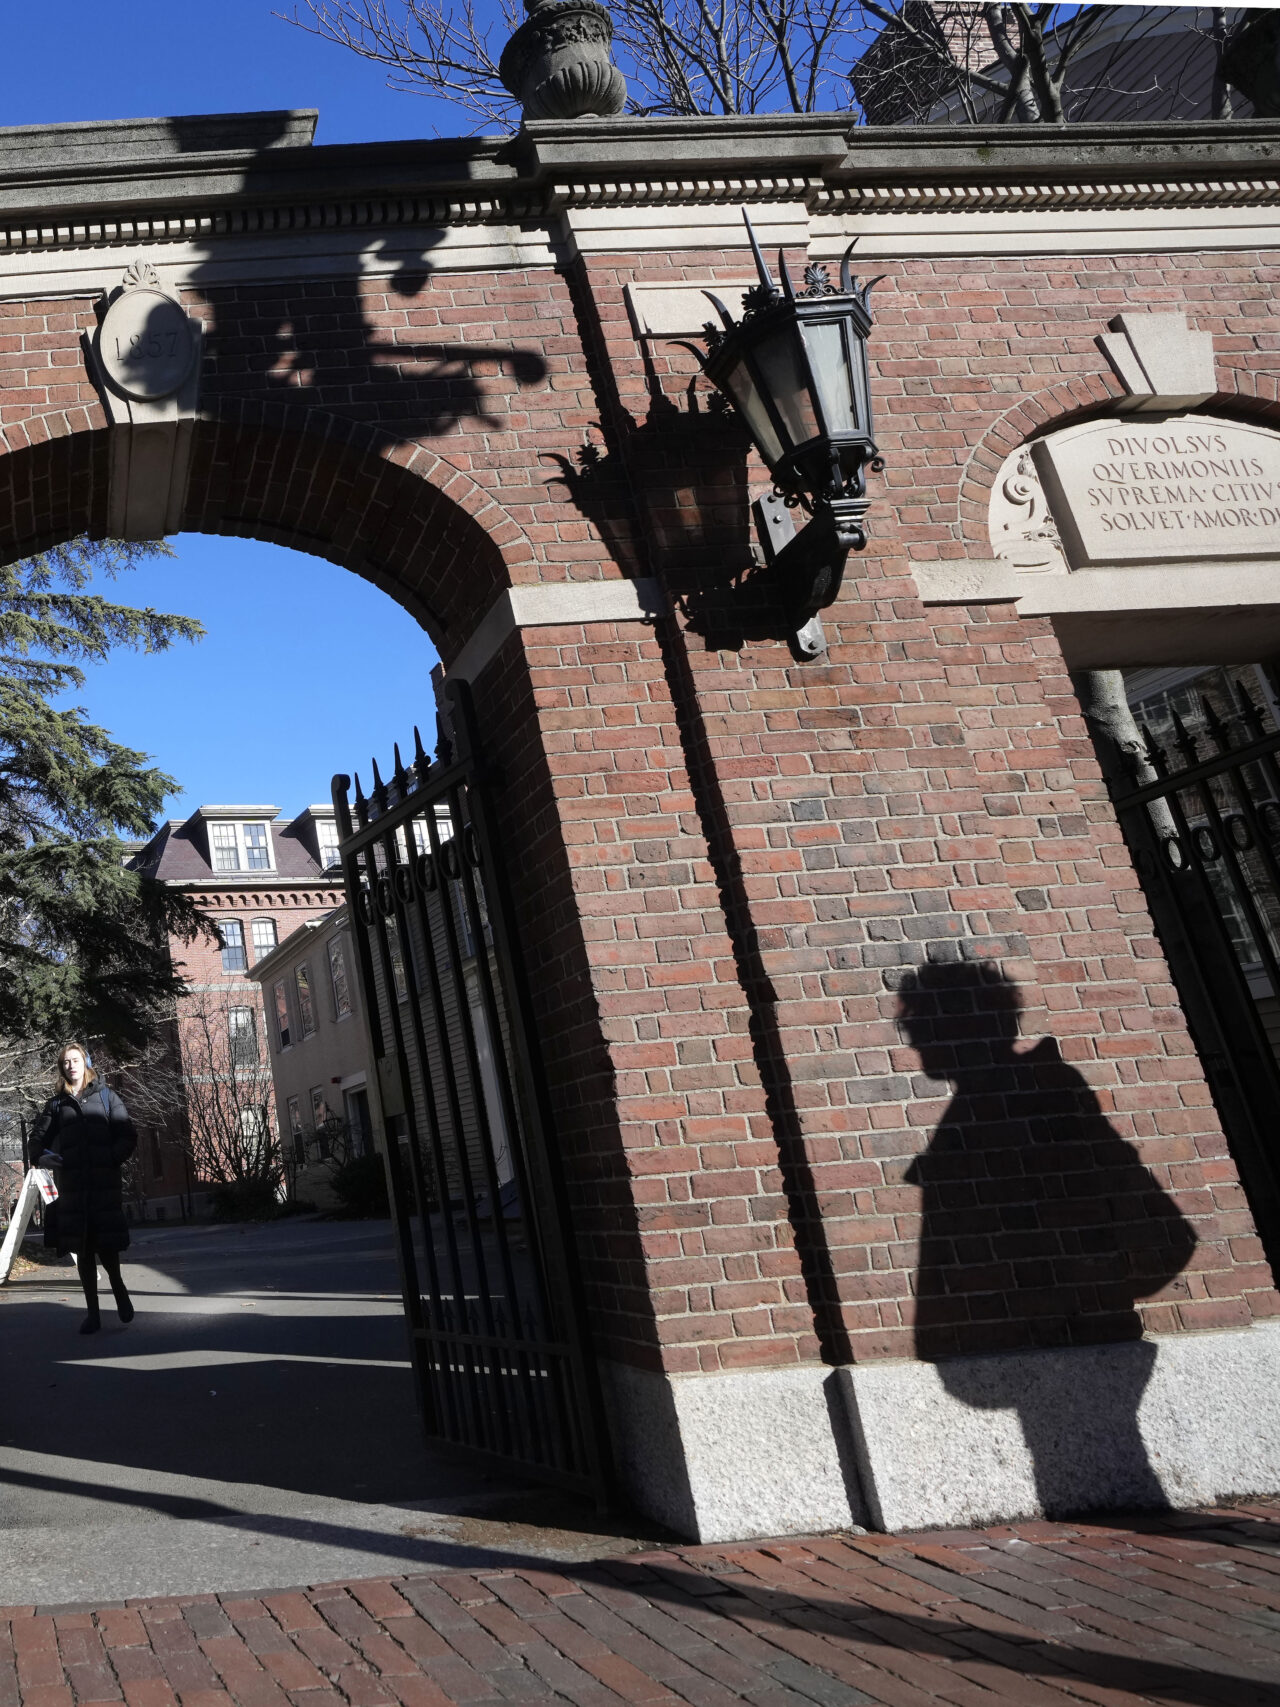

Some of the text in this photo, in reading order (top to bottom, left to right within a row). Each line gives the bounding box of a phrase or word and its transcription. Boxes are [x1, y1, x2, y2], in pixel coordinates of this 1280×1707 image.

[114, 331, 178, 361] 1857
[1106, 435, 1227, 456] DIVOLSVS
[1092, 458, 1264, 485] QVERIMONIIS
[1211, 481, 1280, 502] CITIV
